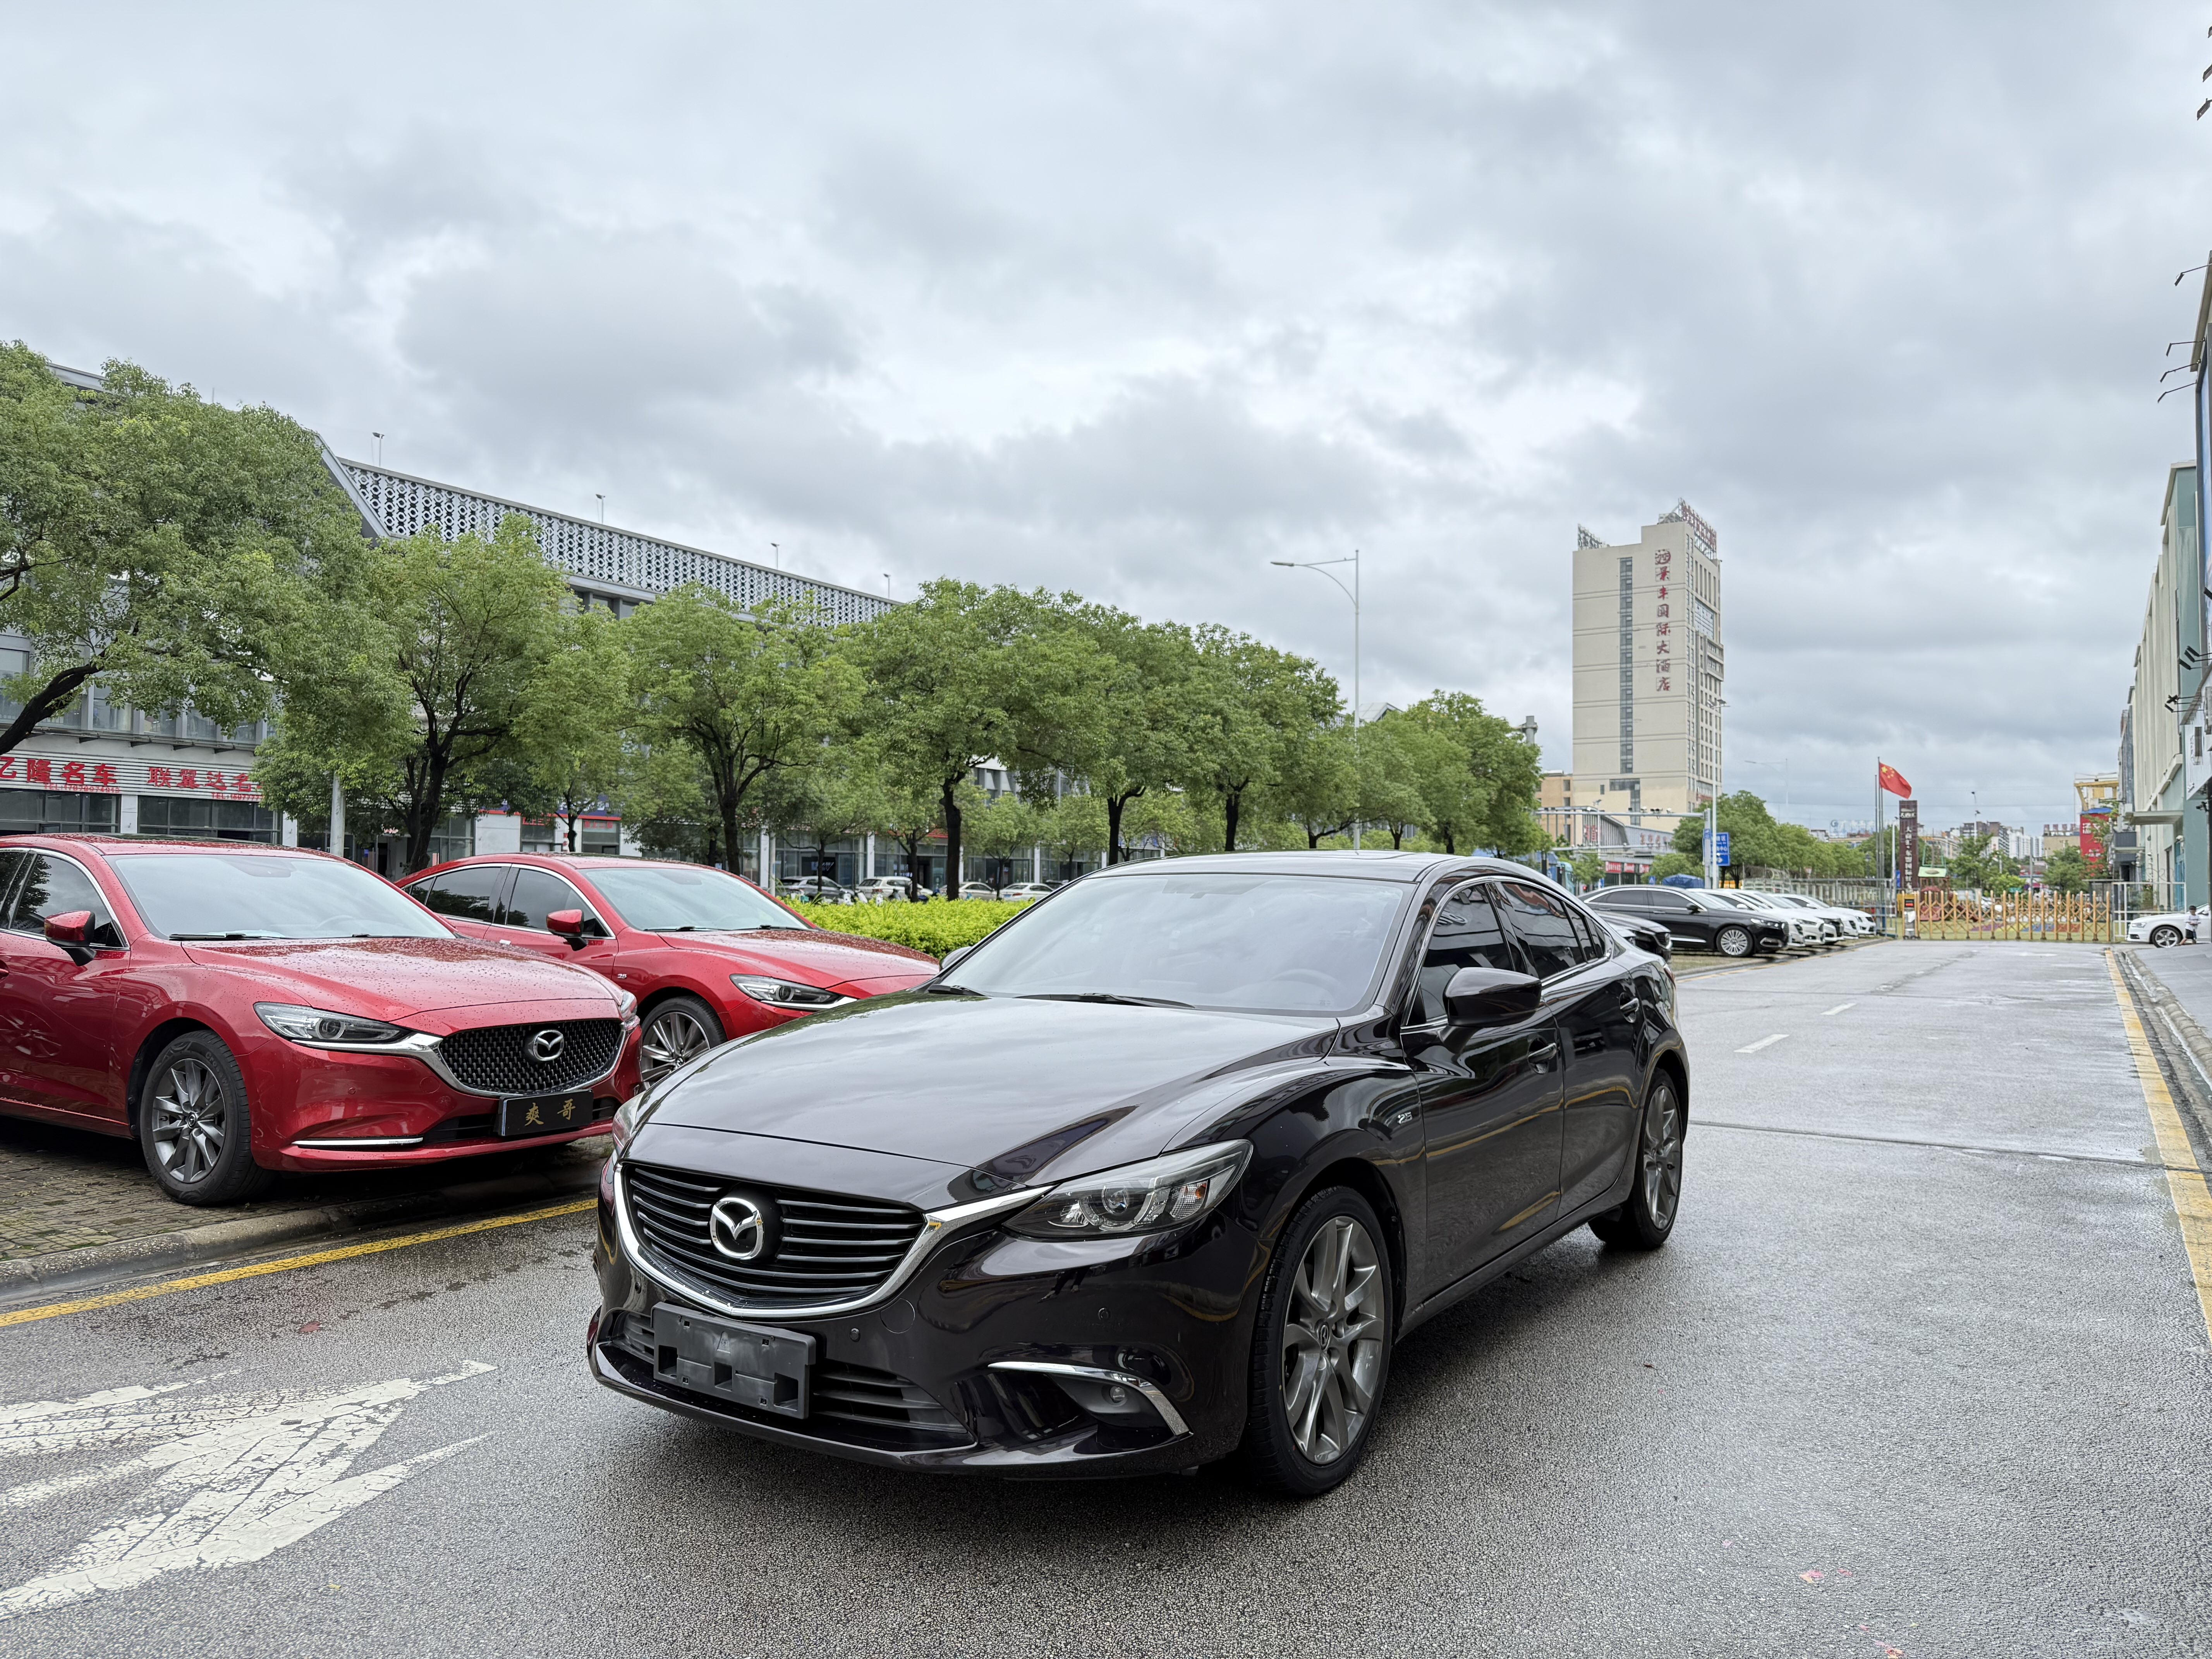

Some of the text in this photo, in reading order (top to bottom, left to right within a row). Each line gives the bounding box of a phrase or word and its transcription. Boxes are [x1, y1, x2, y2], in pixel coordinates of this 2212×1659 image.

[146, 767, 263, 792] 联翼达名
[525, 1098, 576, 1126] 爽哥
